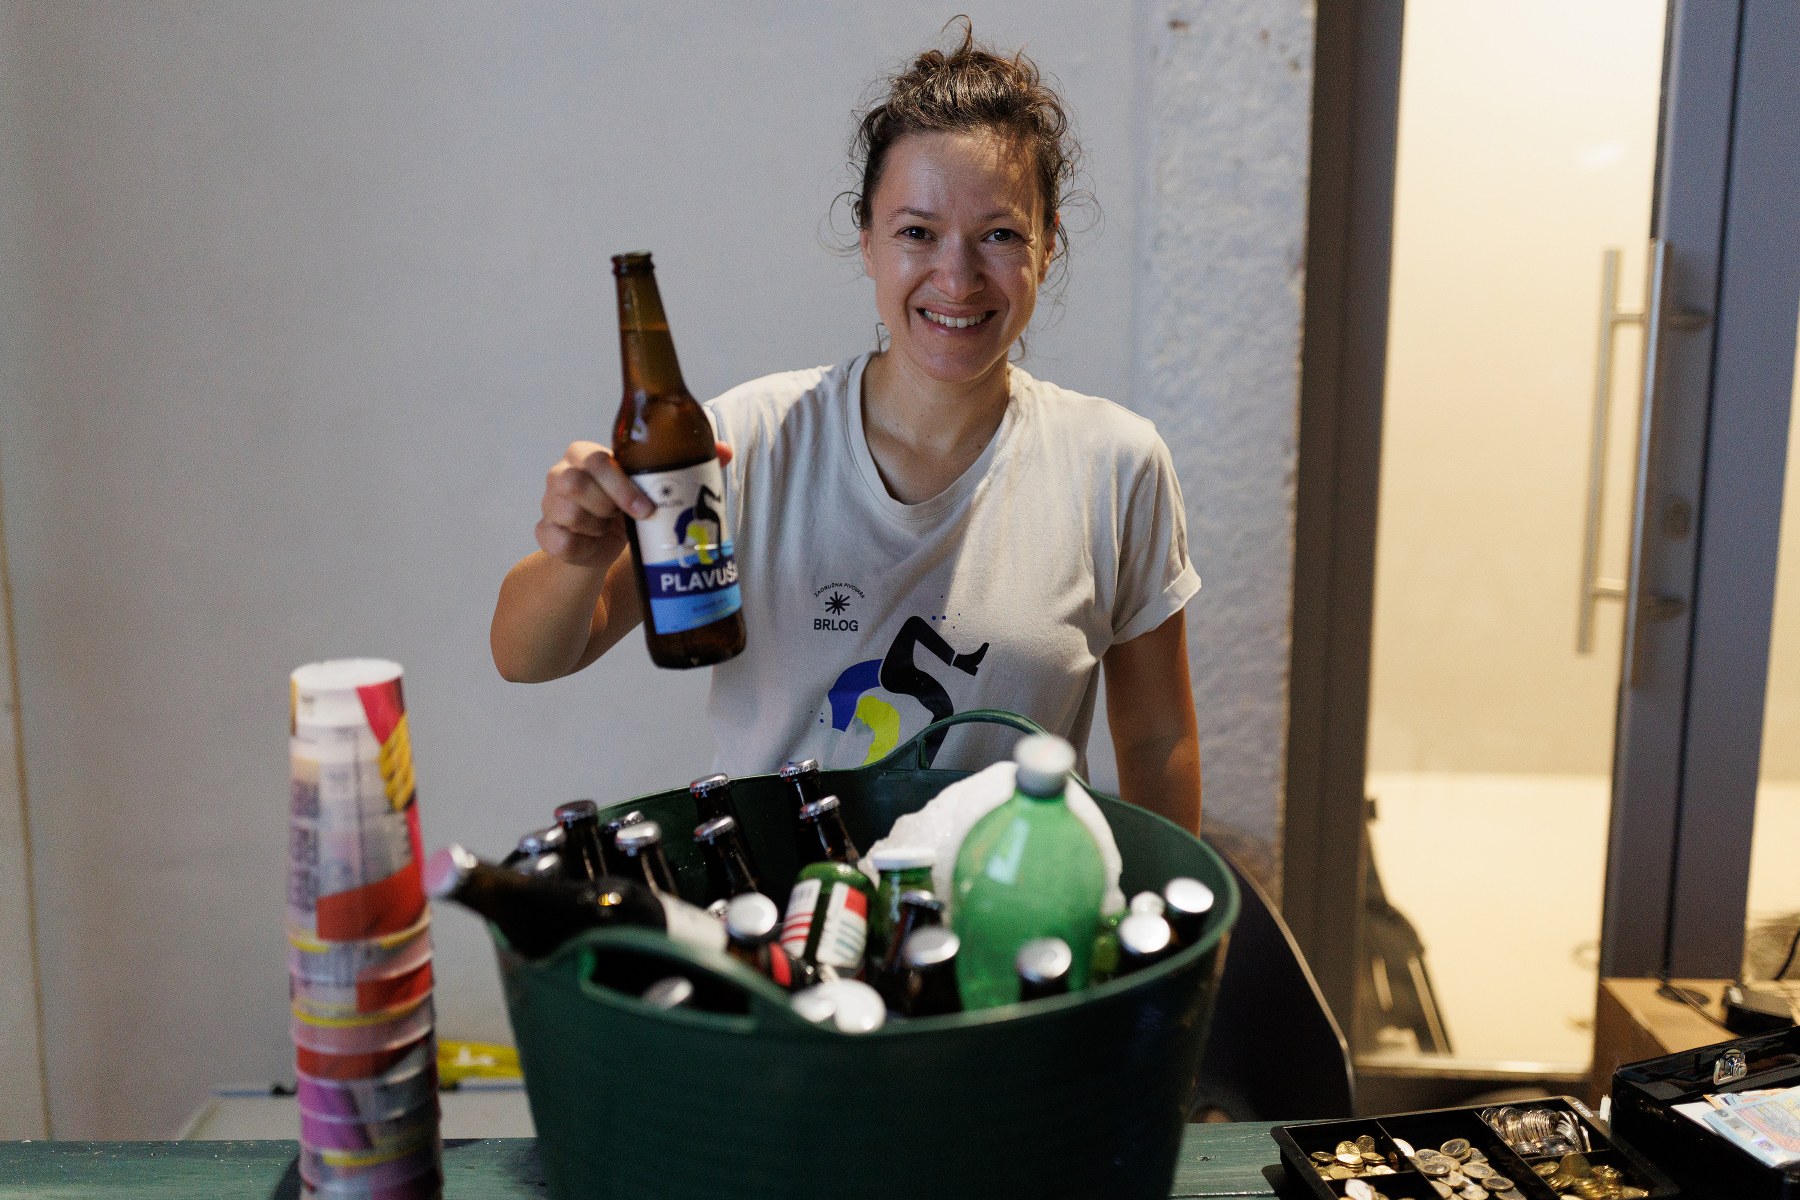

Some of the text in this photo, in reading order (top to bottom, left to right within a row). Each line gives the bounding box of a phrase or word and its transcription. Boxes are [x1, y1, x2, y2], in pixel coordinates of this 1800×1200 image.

[814, 582, 865, 599] ZADRUŽNA PIVOVARA
[813, 618, 859, 632] BRLOG
